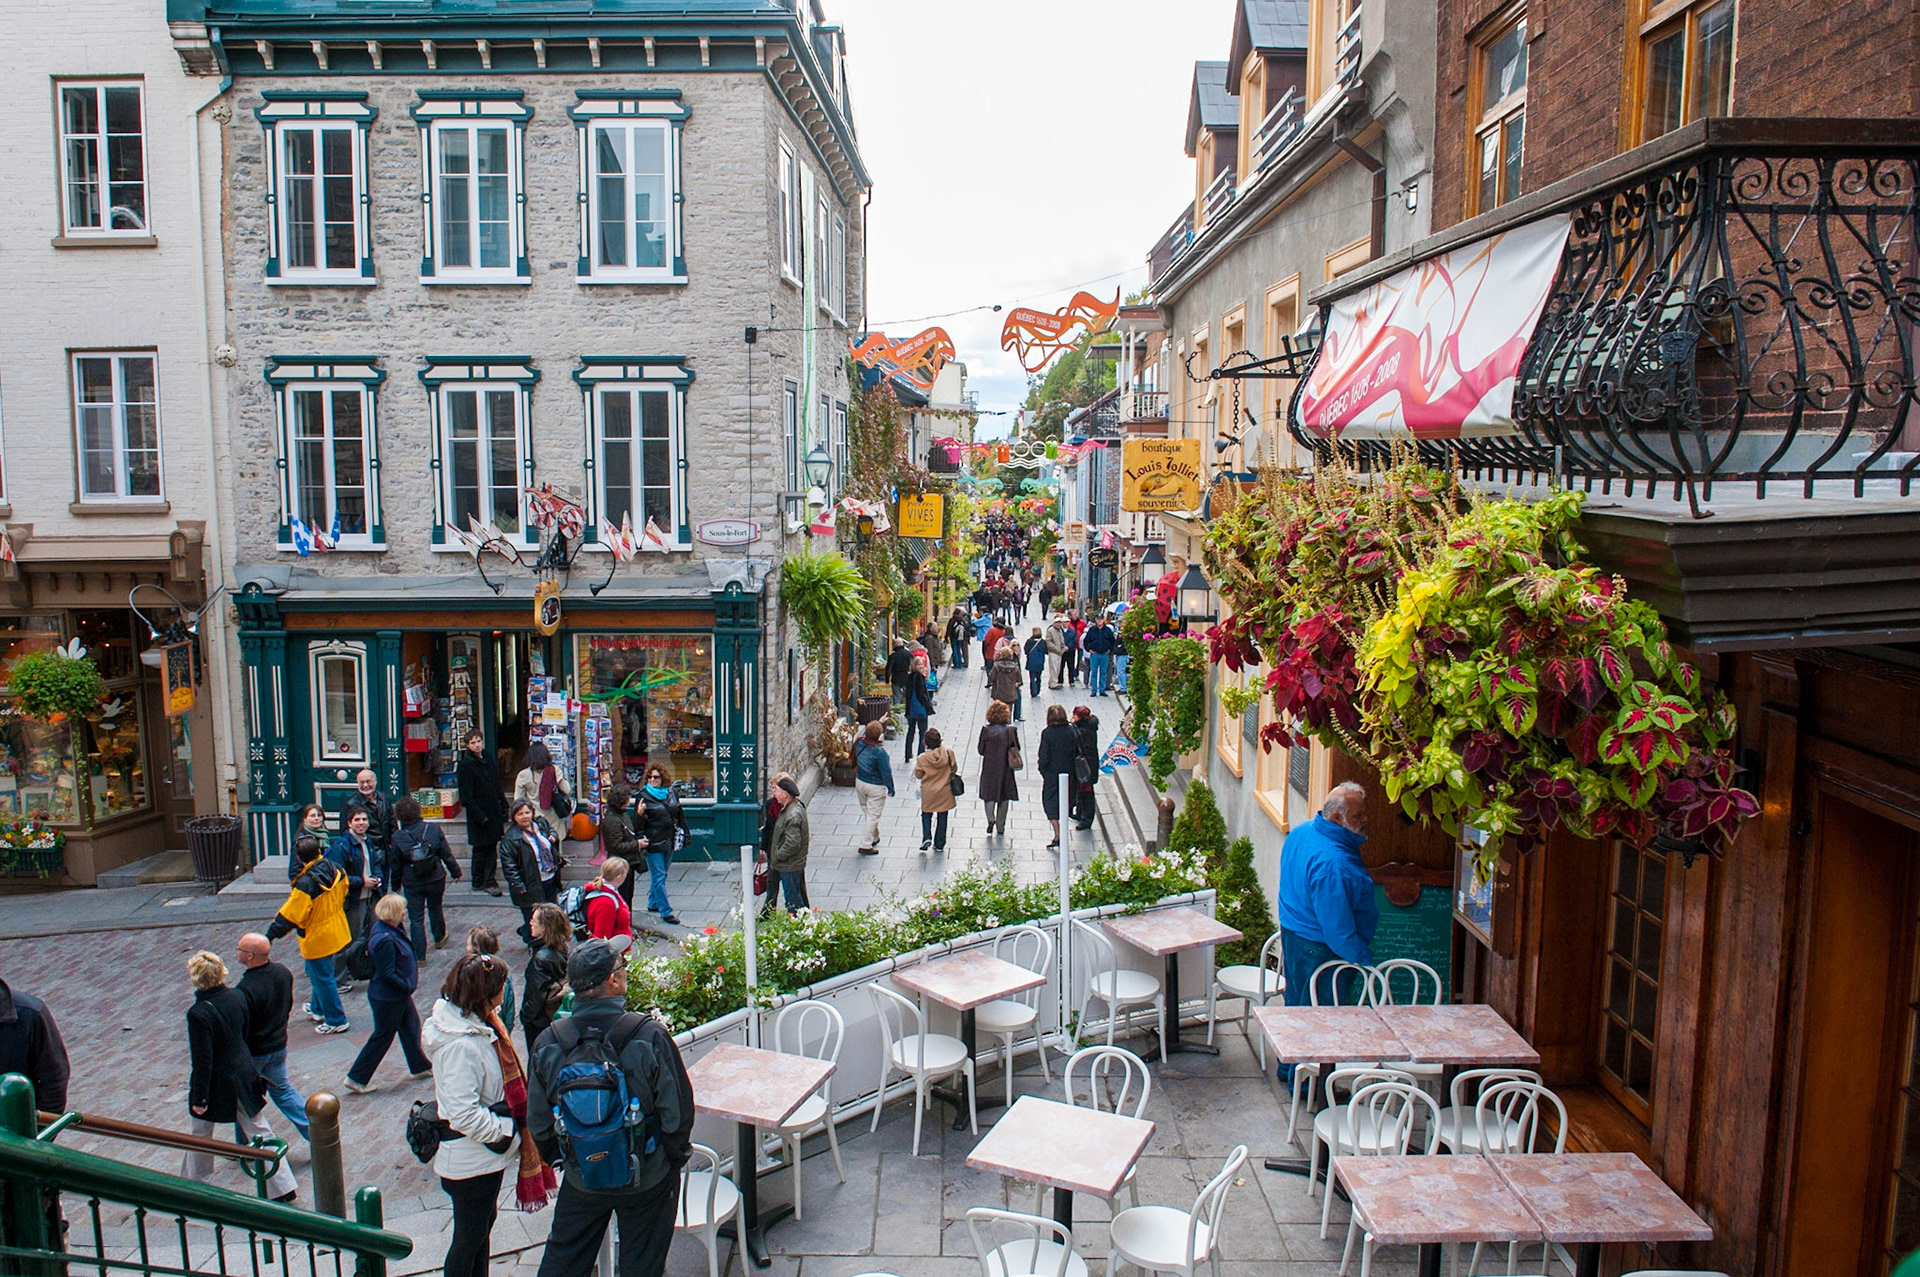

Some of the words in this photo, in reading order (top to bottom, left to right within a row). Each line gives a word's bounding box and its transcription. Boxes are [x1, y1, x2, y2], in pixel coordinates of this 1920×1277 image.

[1015, 311, 1035, 324] QUÉBEC
[1036, 316, 1061, 330] 1608-2008
[896, 342, 914, 358] QUÉBEC
[913, 330, 937, 348] 1608-2008
[1319, 391, 1349, 431] QUÉBEC
[1350, 351, 1400, 406] 1608-2008
[1142, 442, 1182, 455] boutique
[1124, 460, 1162, 483] Louis
[1163, 456, 1200, 482] Jolliet
[907, 508, 935, 522] VIVES
[709, 529, 748, 537] Sous-le-Fort
